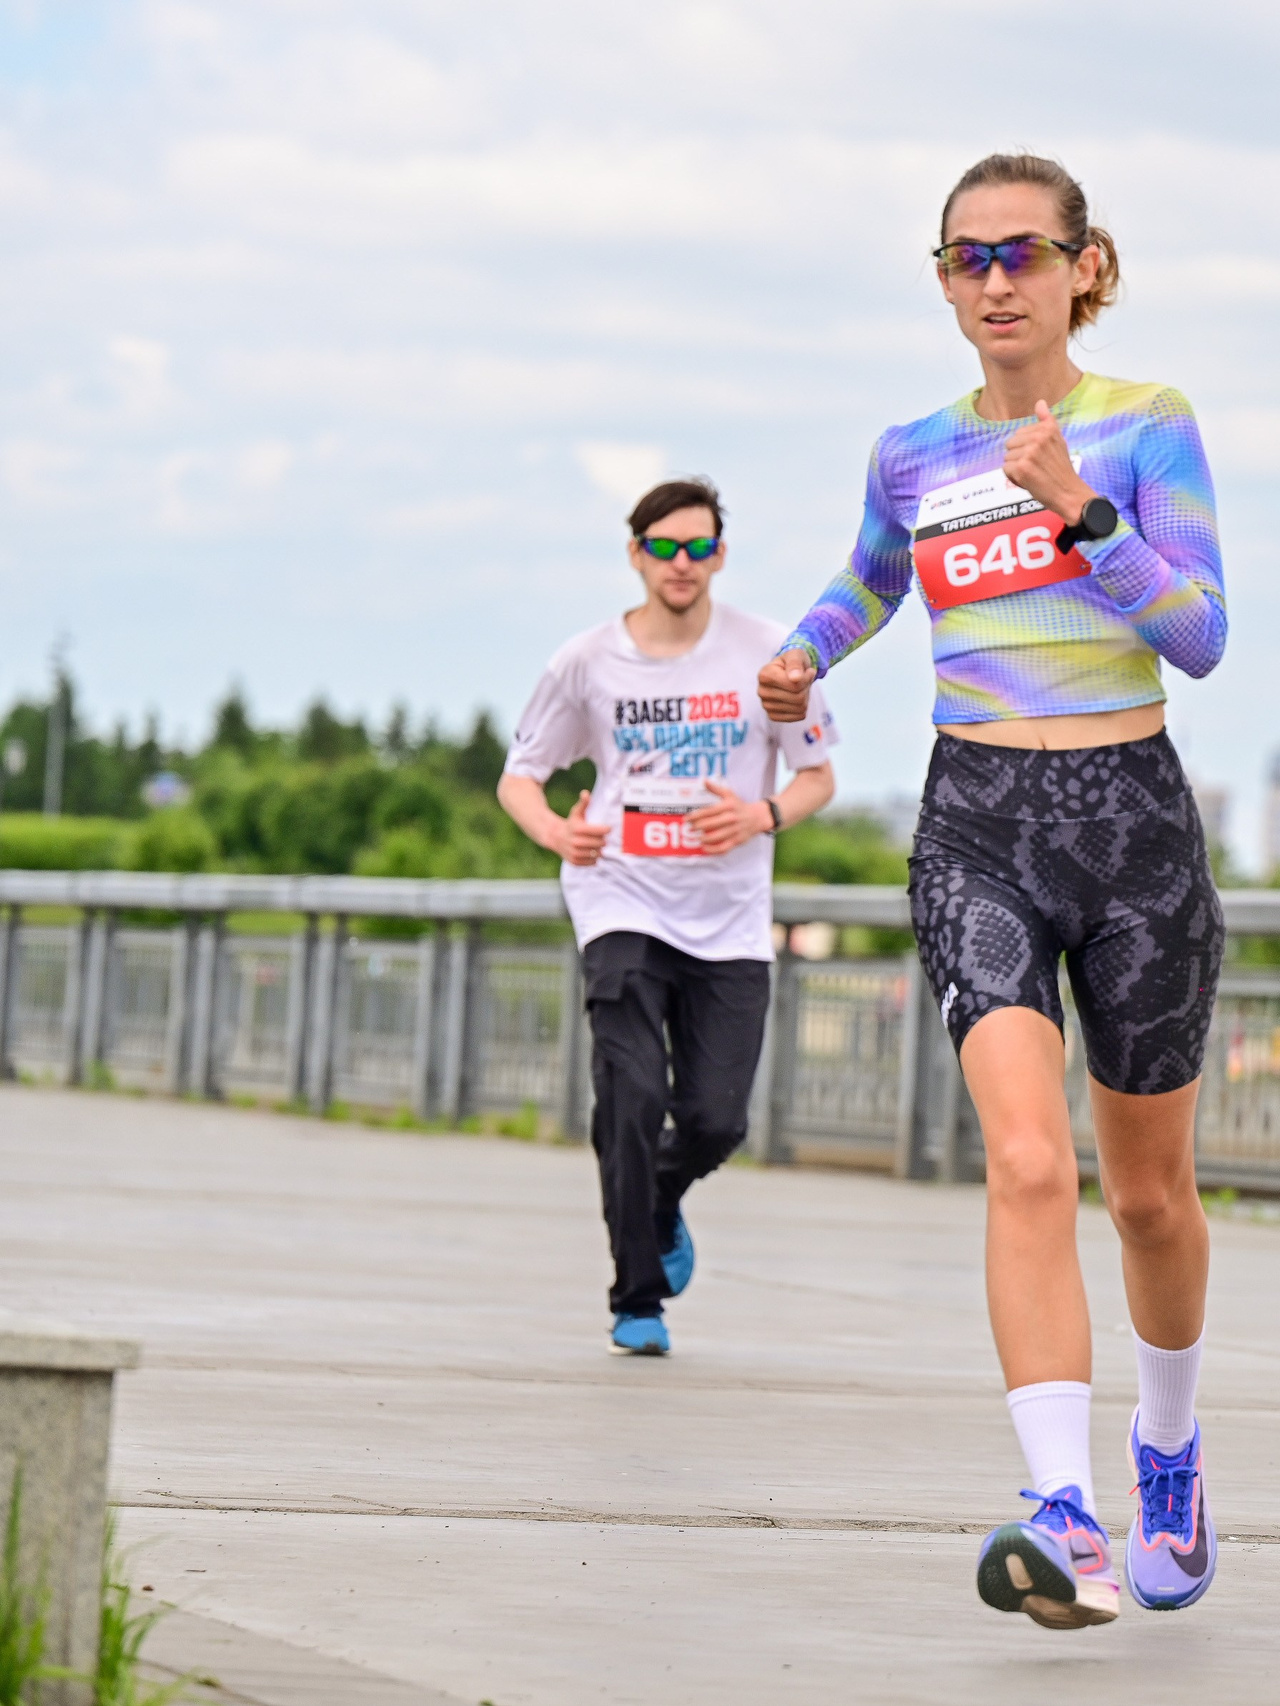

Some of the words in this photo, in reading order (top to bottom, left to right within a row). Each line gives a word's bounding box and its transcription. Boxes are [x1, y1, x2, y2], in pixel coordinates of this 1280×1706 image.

[940, 504, 1018, 533] ТАТАРСТАН
[1019, 499, 1045, 515] 202
[943, 525, 1056, 587] 646
[669, 749, 730, 777] БЕГУТ
